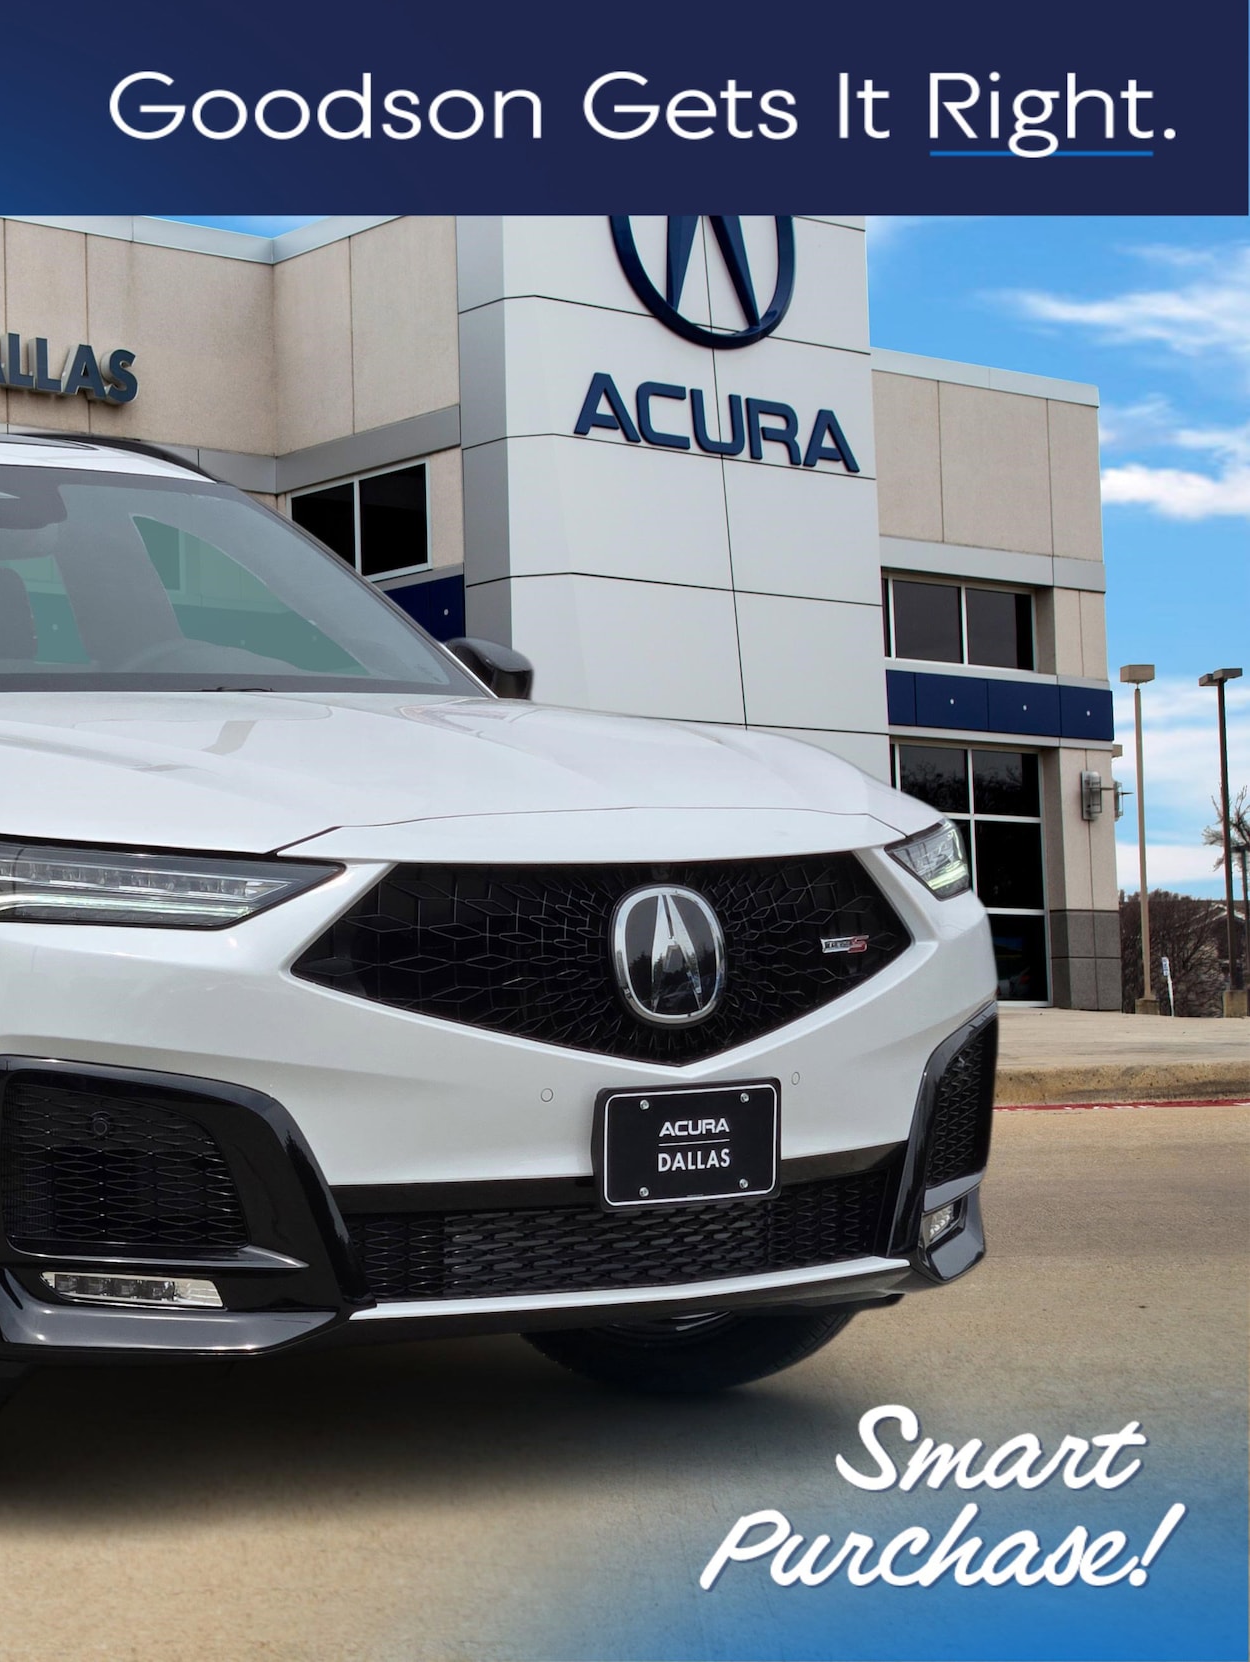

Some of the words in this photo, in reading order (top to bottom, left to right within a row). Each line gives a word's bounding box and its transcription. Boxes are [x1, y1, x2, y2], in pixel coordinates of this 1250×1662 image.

[574, 372, 860, 473] ACURA
[659, 1117, 730, 1138] ACURA
[657, 1147, 731, 1173] DALLAS
